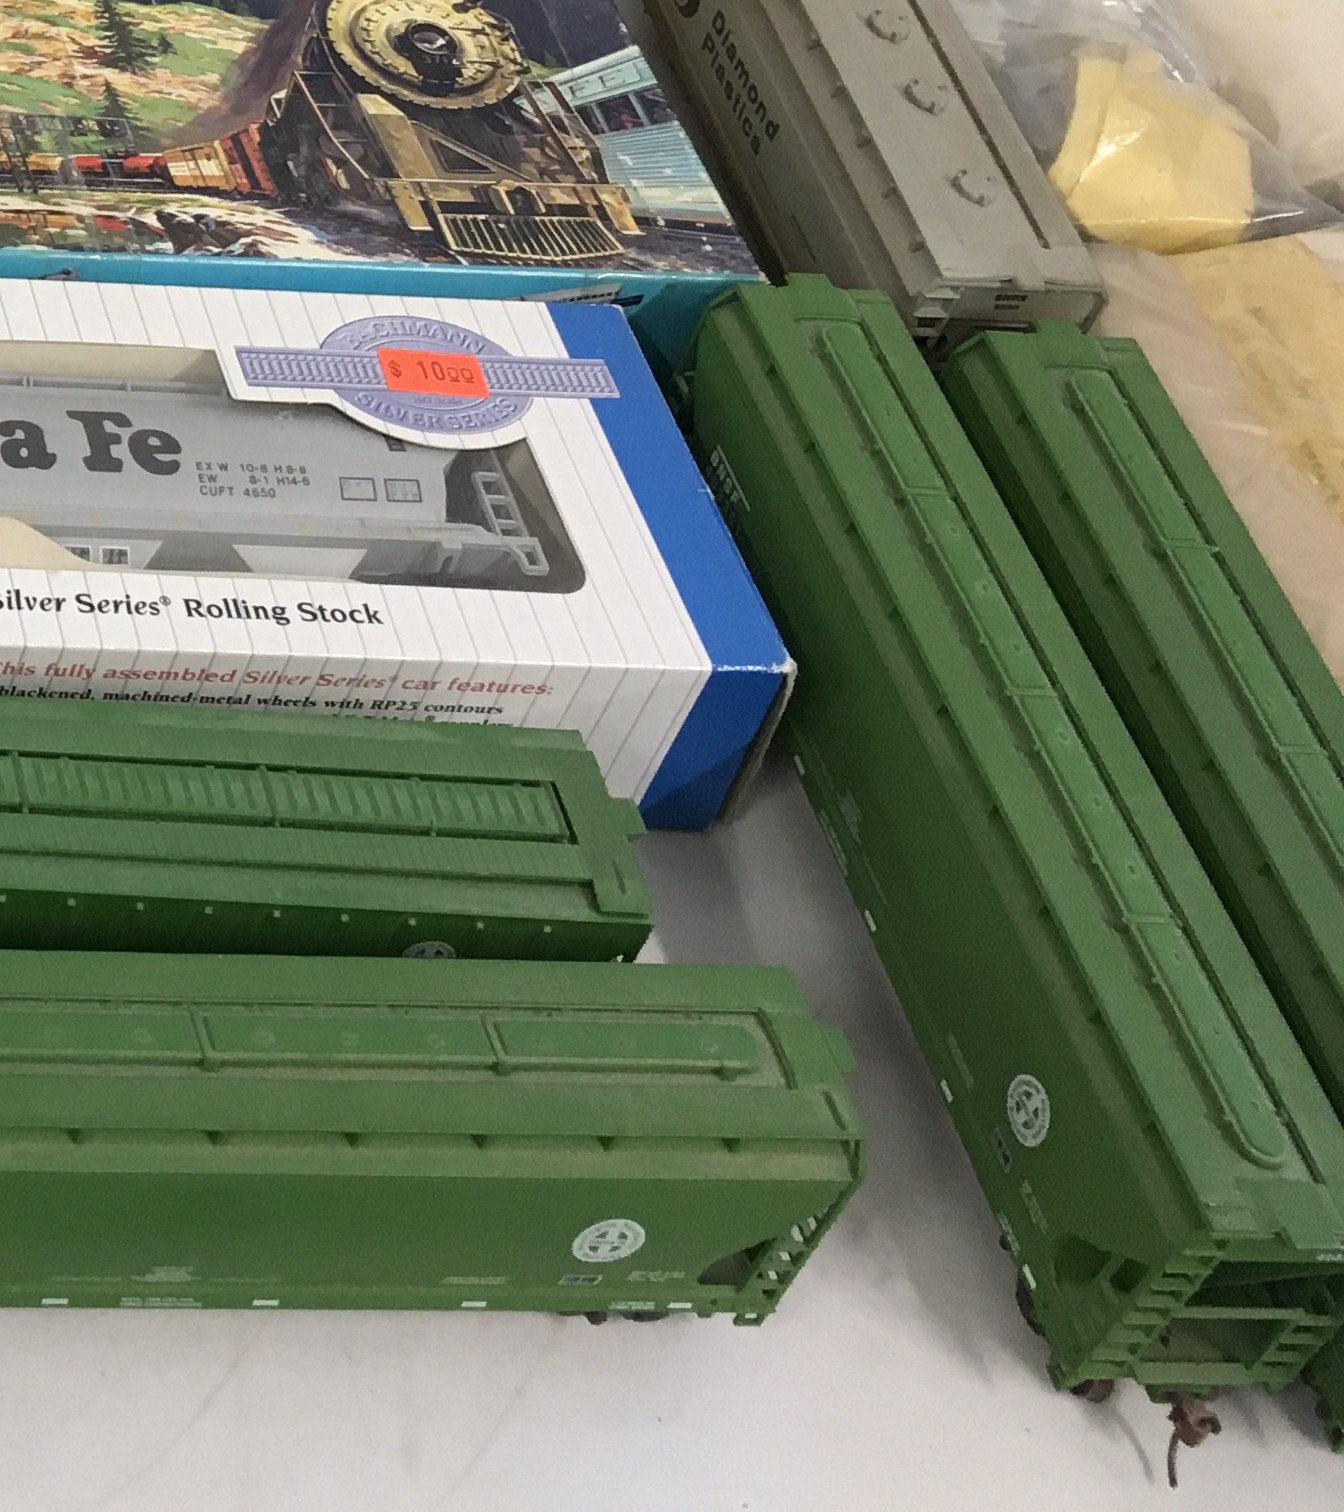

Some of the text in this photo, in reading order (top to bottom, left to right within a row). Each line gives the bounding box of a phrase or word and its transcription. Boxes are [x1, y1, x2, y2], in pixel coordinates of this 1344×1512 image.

[712, 8, 781, 143] Diamond
[700, 32, 762, 157] Plastics
[353, 391, 519, 430] SILVER SERIES
[65, 407, 183, 476] Fe
[196, 473, 219, 485] EW
[242, 486, 277, 500] 4650
[184, 597, 292, 627] Rolling
[297, 601, 385, 626] Stock
[44, 662, 97, 684] fully
[102, 666, 237, 687] assembled
[242, 669, 312, 689] Silver
[401, 678, 441, 694] car
[447, 678, 554, 697] features:
[101, 688, 252, 708] machined-metal
[255, 693, 317, 710] wheels
[322, 696, 365, 711] with
[368, 698, 419, 715] RP25
[422, 701, 505, 717] contours
